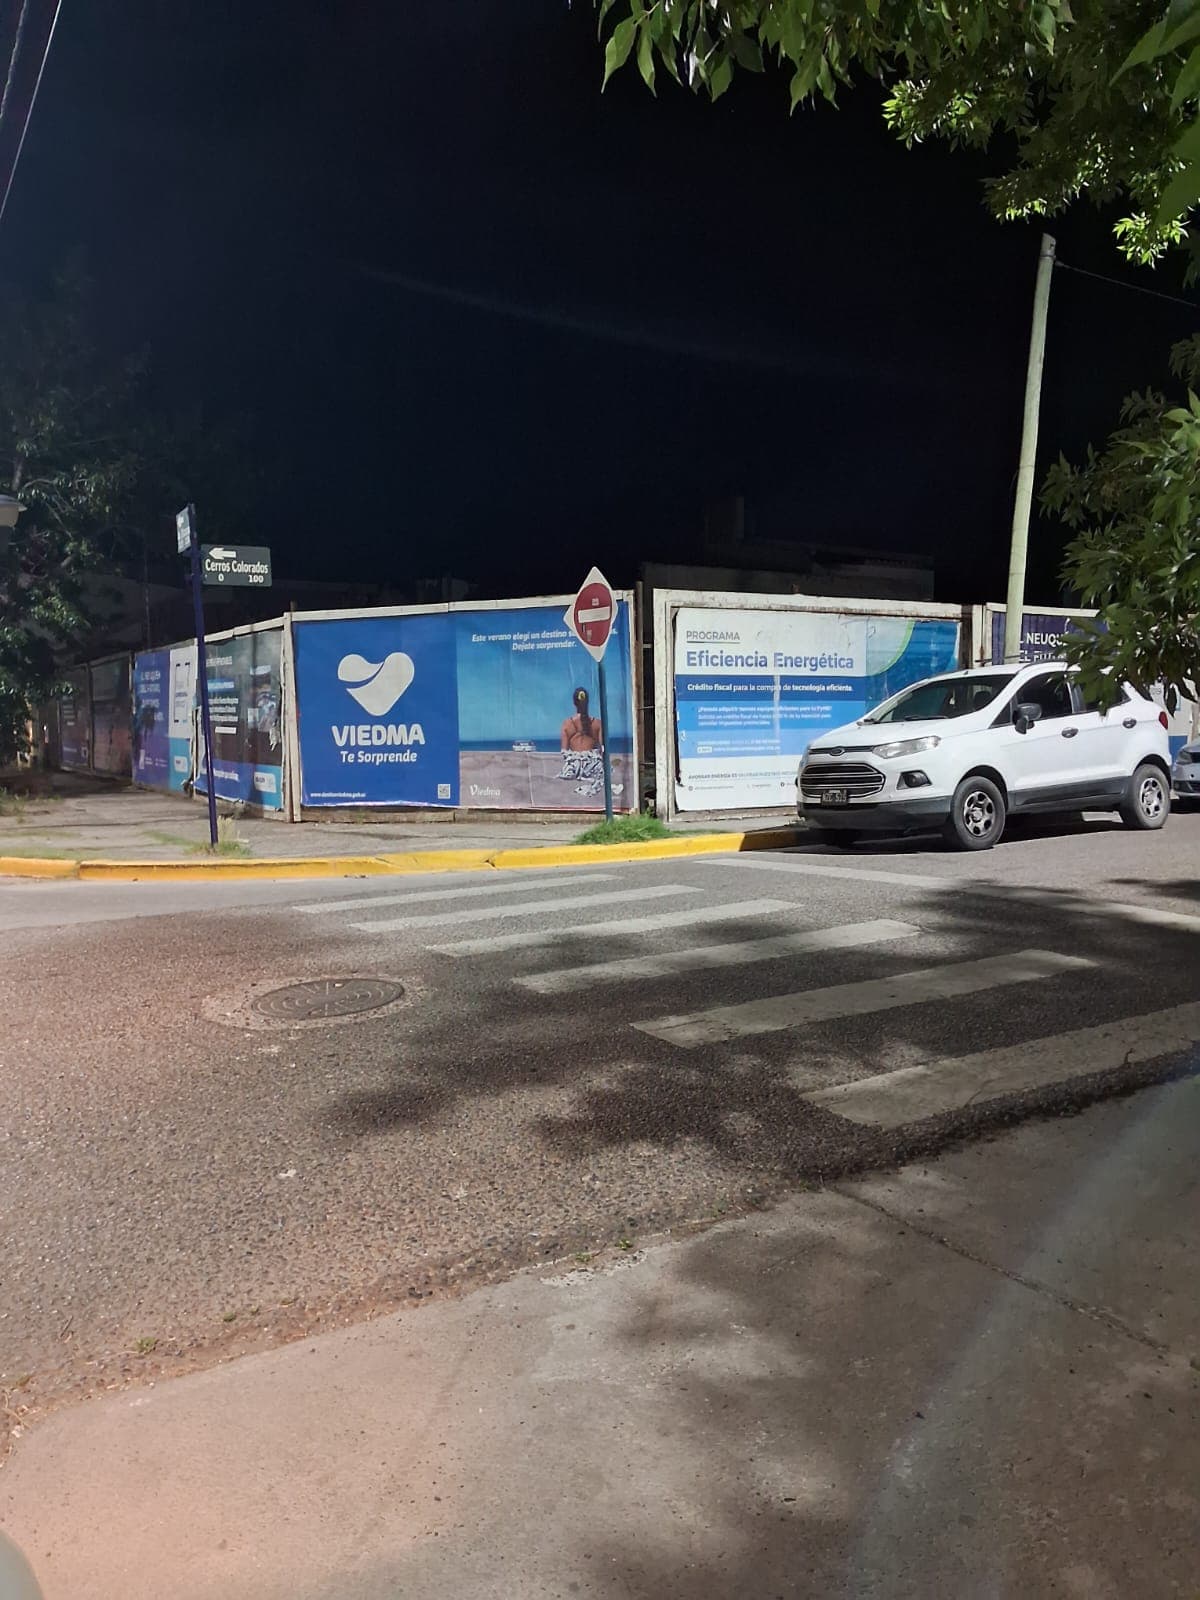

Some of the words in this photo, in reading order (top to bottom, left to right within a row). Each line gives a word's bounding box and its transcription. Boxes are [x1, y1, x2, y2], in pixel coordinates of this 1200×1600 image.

[205, 559, 230, 572] Cerros
[231, 560, 268, 574] Colorados
[218, 573, 224, 582] 0
[249, 575, 264, 583] 100
[472, 634, 486, 642] Este
[541, 630, 567, 639] destino
[686, 630, 740, 641] PROGRAMA
[1026, 632, 1067, 647] NEUQU
[686, 650, 768, 668] Eficiencia
[773, 652, 854, 671] Energética
[687, 683, 713, 691] Crédito
[714, 683, 732, 691] fiscal
[792, 684, 826, 692] tecnología
[826, 684, 853, 692] eficiente.
[331, 723, 426, 747] VIEDMA
[340, 751, 355, 763] Te
[357, 749, 417, 766] Sorprende
